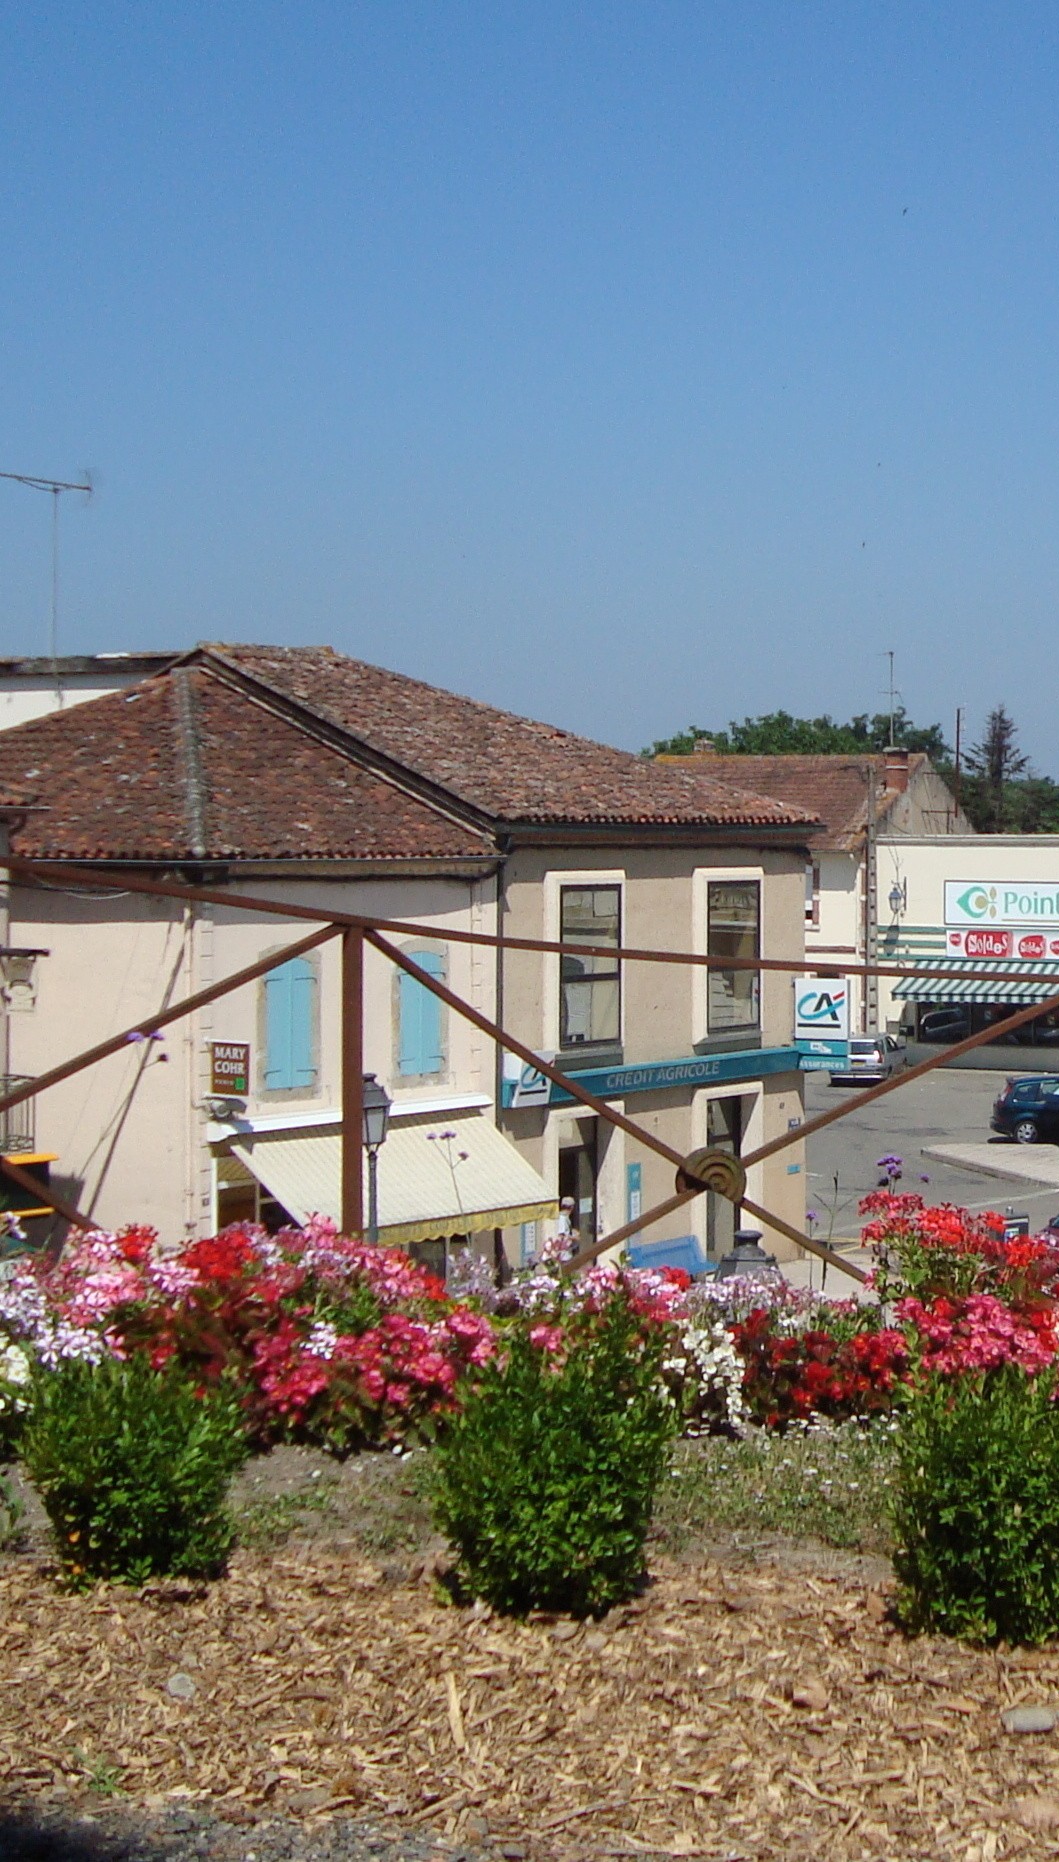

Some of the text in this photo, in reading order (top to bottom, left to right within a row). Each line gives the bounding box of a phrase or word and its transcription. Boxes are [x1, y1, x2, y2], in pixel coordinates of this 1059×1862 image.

[214, 1046, 245, 1060] MARY
[214, 1061, 245, 1074] COHR
[656, 1061, 720, 1081] AGRICOLE
